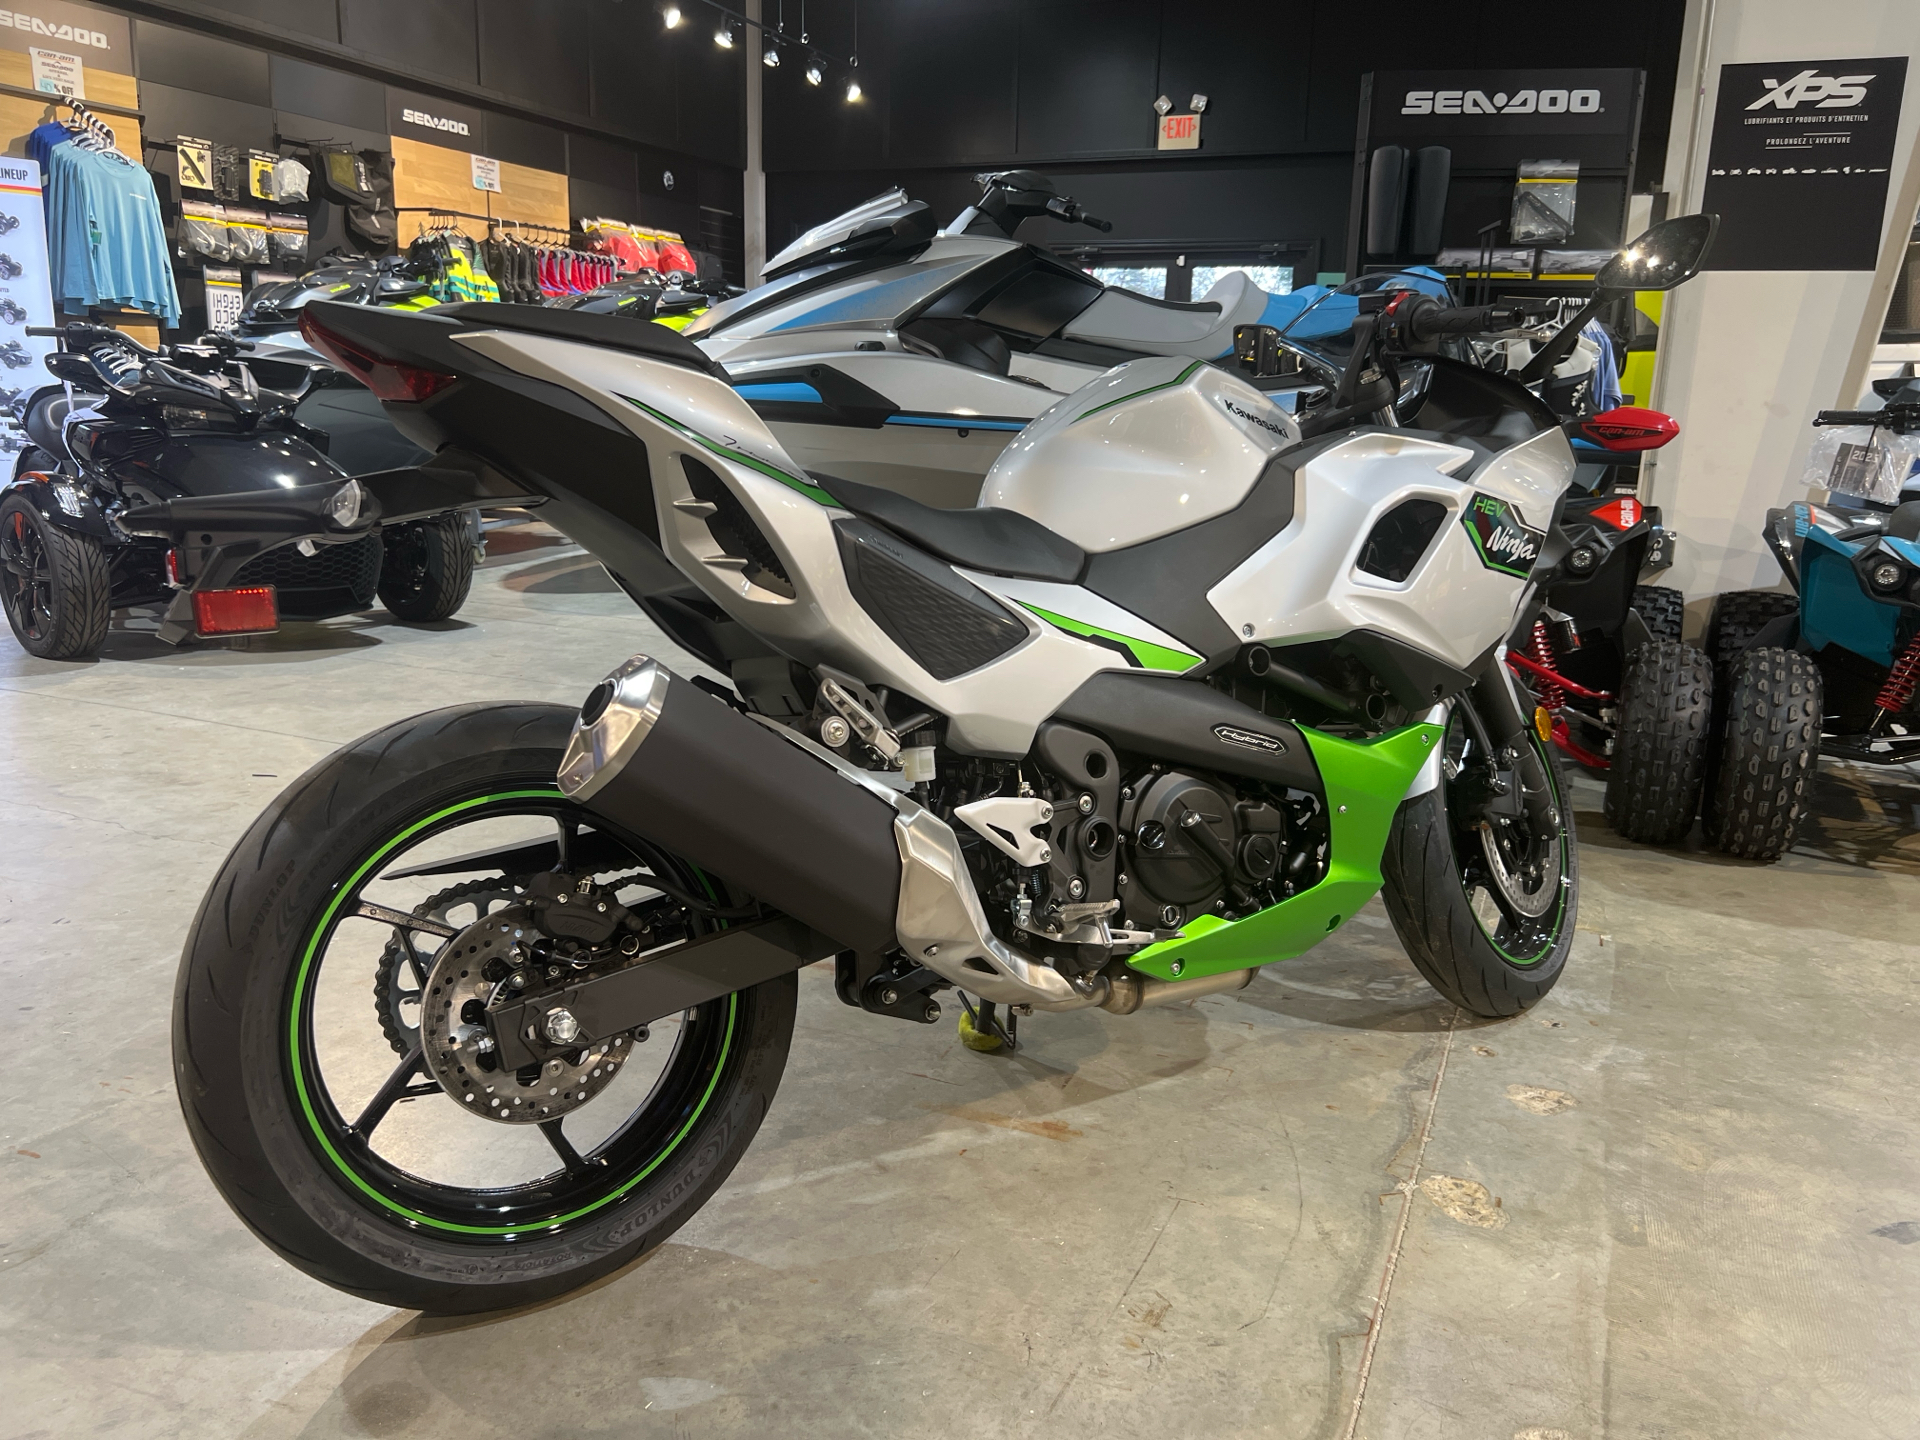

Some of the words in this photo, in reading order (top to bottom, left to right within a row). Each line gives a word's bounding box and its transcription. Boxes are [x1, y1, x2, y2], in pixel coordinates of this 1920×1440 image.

[1744, 70, 1877, 110] XPS
[1166, 117, 1194, 139] EXIT
[1744, 116, 1784, 125] LUBRIFIANTS
[1786, 116, 1793, 124] ET
[1795, 115, 1826, 124] PRODUITS
[1828, 114, 1869, 123] D'ENTRETIEN
[1766, 137, 1806, 145] PROLONGEZ
[1809, 136, 1850, 145] L'AVENTURE
[1224, 399, 1289, 439] Kawasaki
[1473, 497, 1506, 518] HEV
[1486, 525, 1536, 563] Ninja
[1221, 730, 1278, 749] Hybrid
[618, 1169, 698, 1237] DUNLOP
